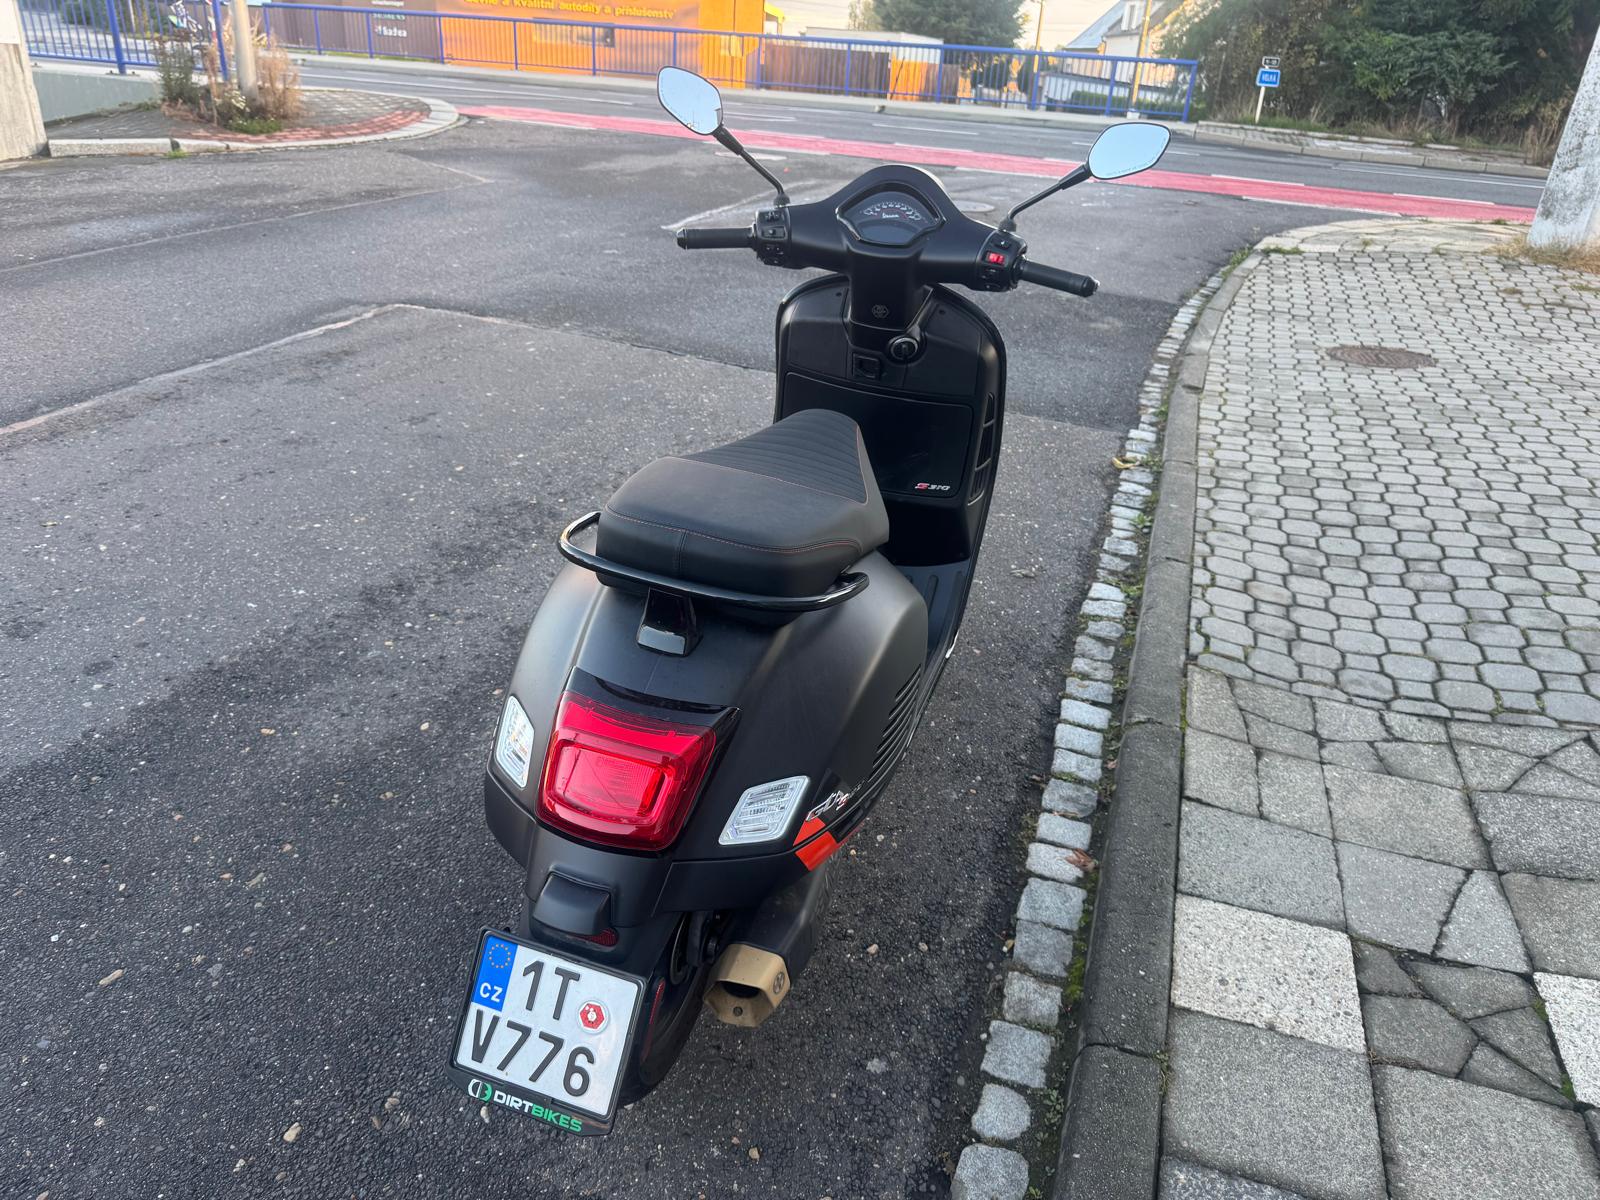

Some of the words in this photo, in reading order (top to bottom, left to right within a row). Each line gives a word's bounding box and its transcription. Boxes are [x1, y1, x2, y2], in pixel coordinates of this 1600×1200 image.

[604, 5, 612, 14] a
[479, 982, 504, 1003] CZ
[522, 960, 581, 1021] 1T
[471, 1009, 596, 1098] V776
